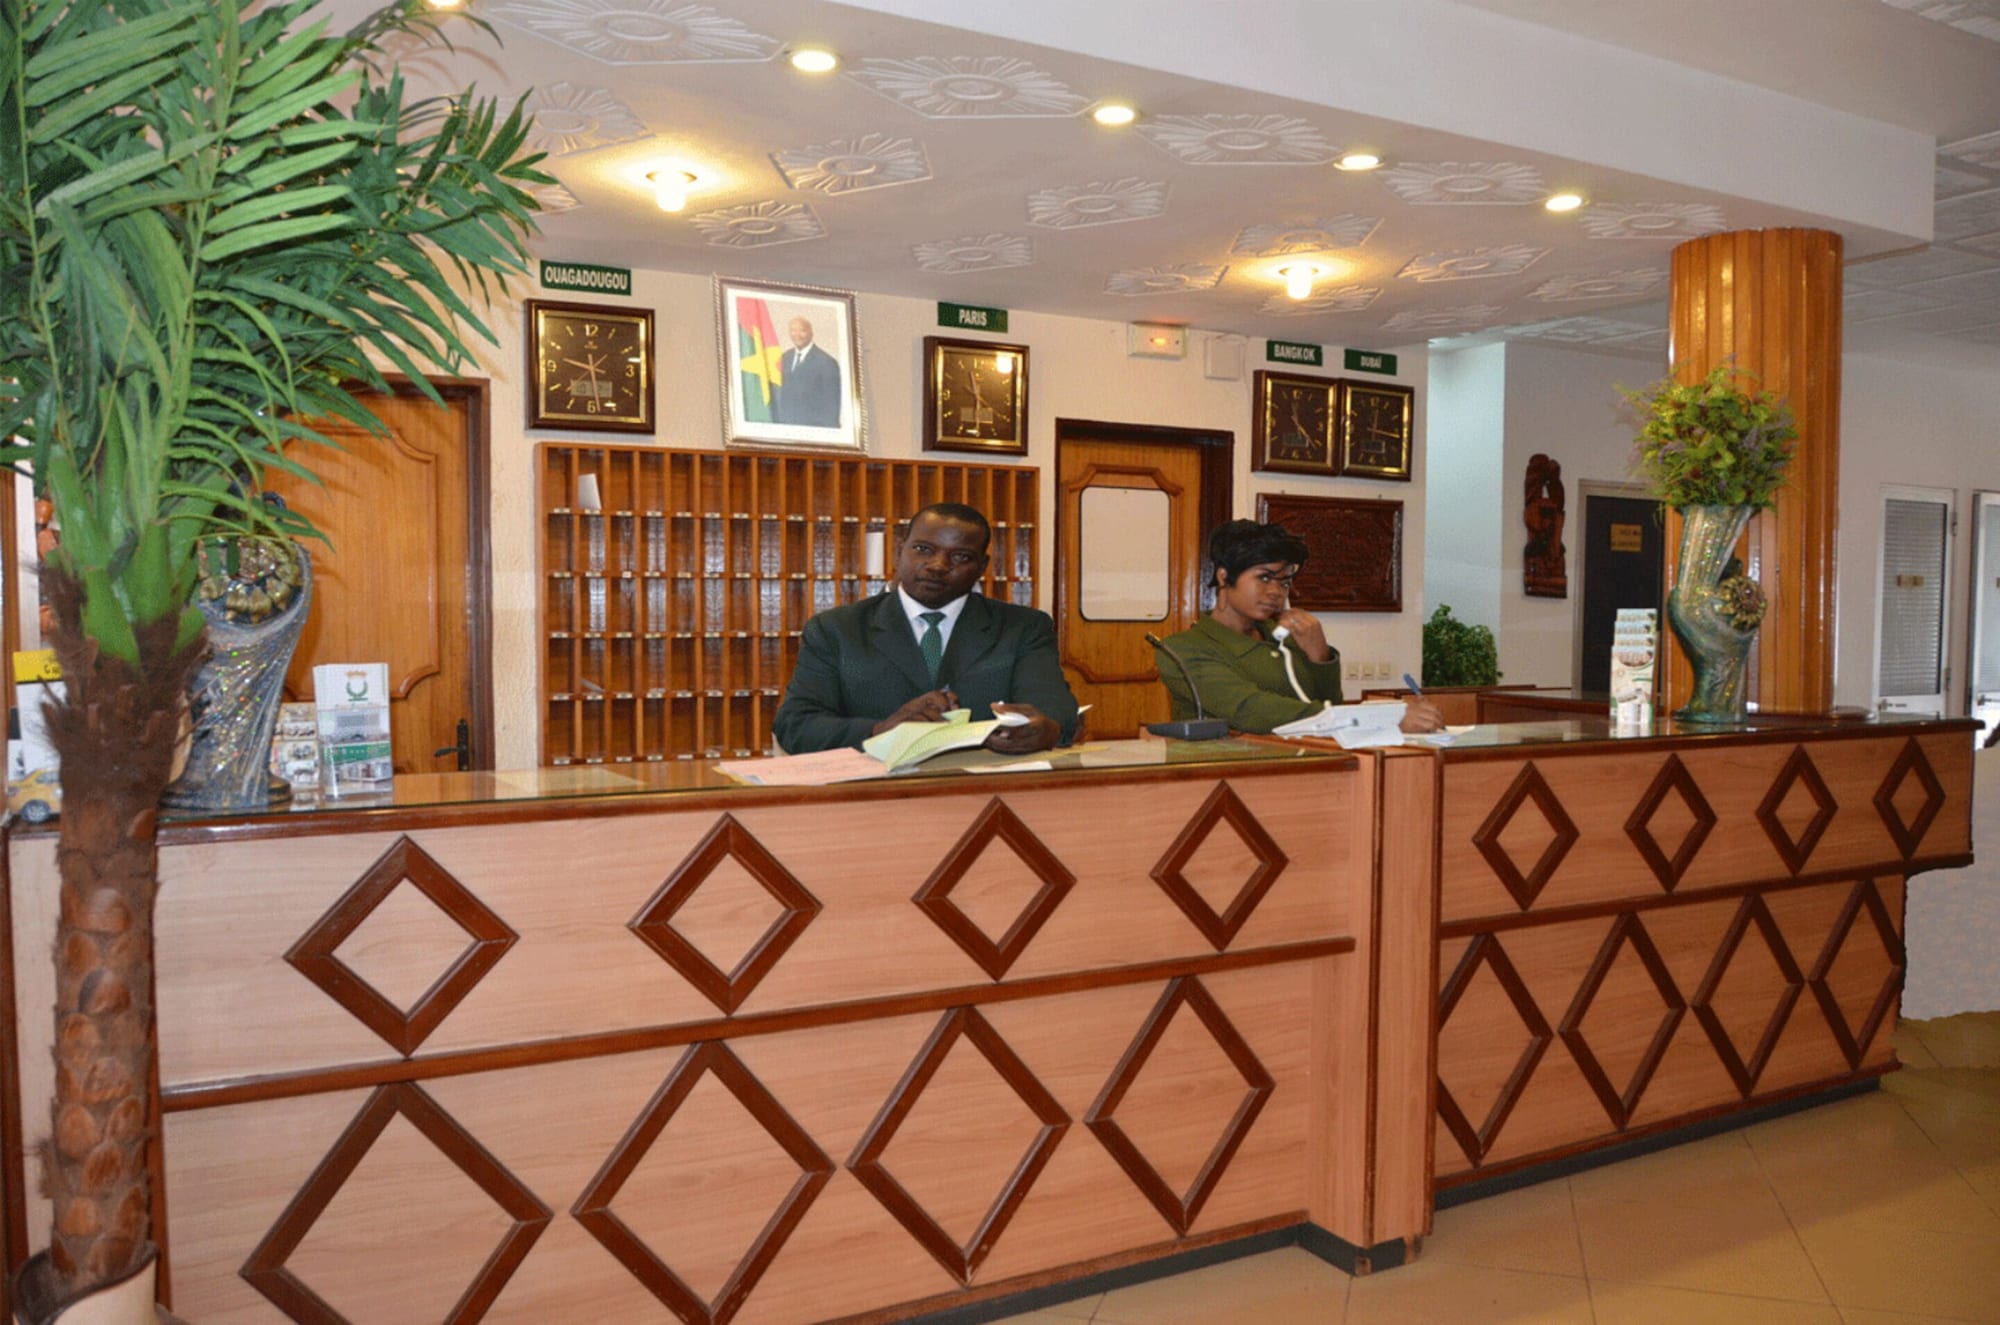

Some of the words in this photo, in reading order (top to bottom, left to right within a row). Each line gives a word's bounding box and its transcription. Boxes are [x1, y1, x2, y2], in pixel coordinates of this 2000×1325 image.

[545, 266, 627, 290] OUAGADOUGOU
[958, 308, 988, 327] PARIS
[584, 324, 599, 337] 12
[1274, 343, 1316, 362] BANGKOK
[547, 360, 557, 372] 9
[626, 365, 635, 377] 3
[587, 400, 596, 413] 6
